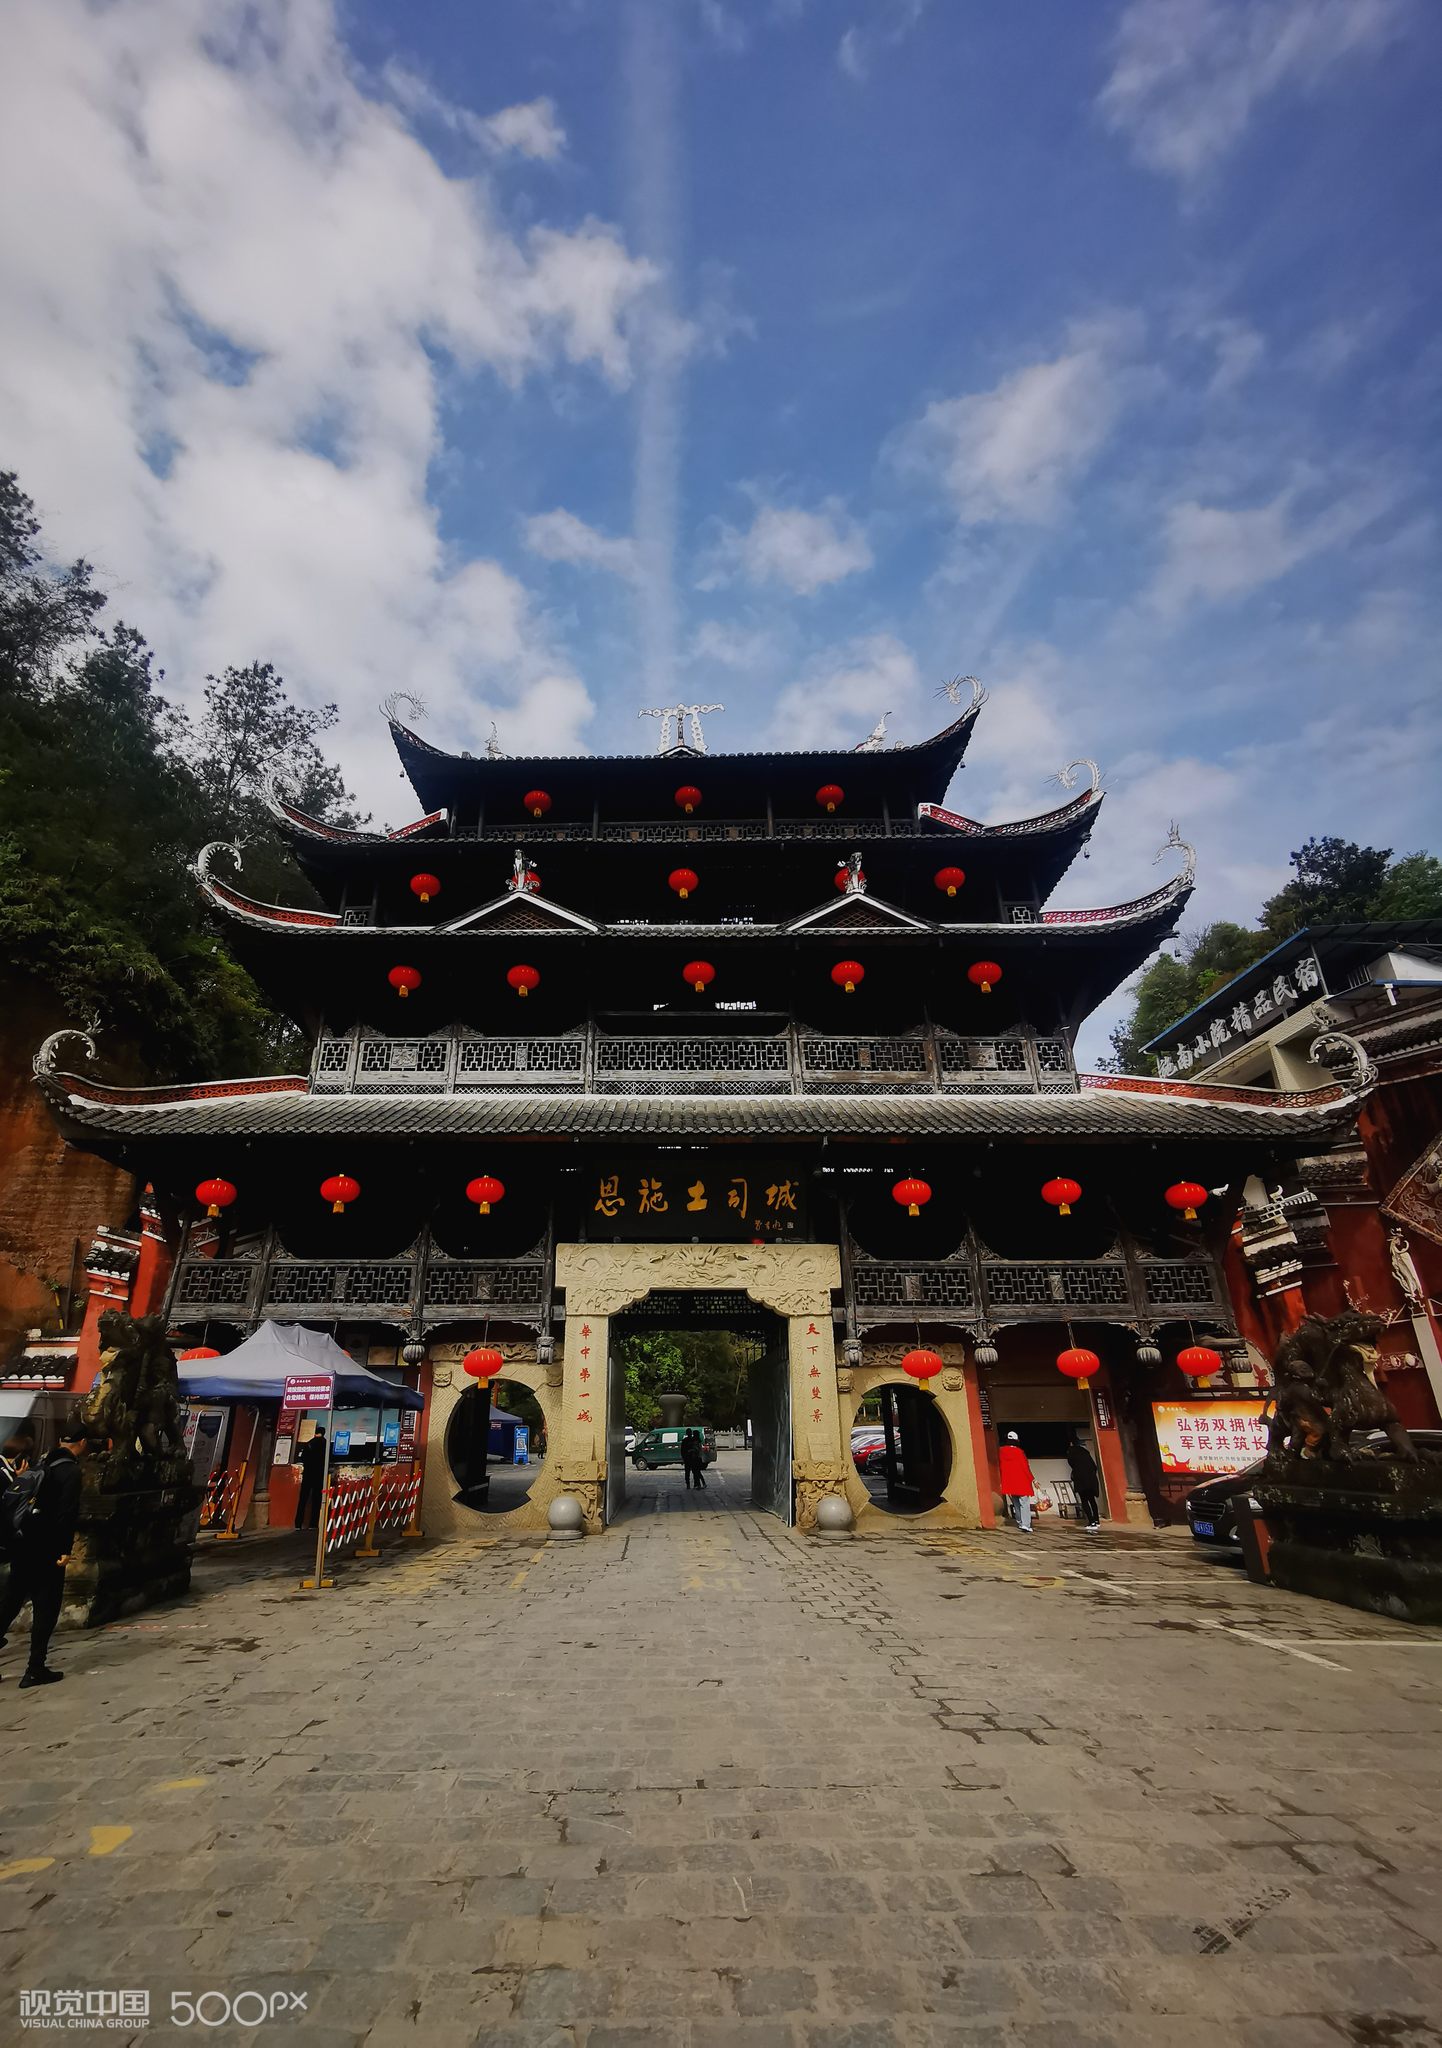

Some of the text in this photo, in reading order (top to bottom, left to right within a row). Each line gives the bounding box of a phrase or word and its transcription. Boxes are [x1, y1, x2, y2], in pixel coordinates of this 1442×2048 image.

[594, 1175, 800, 1219] 恩施土司城
[806, 1322, 823, 1423] 天下無雙景
[1180, 1435, 1267, 1451] 军民共筑长
